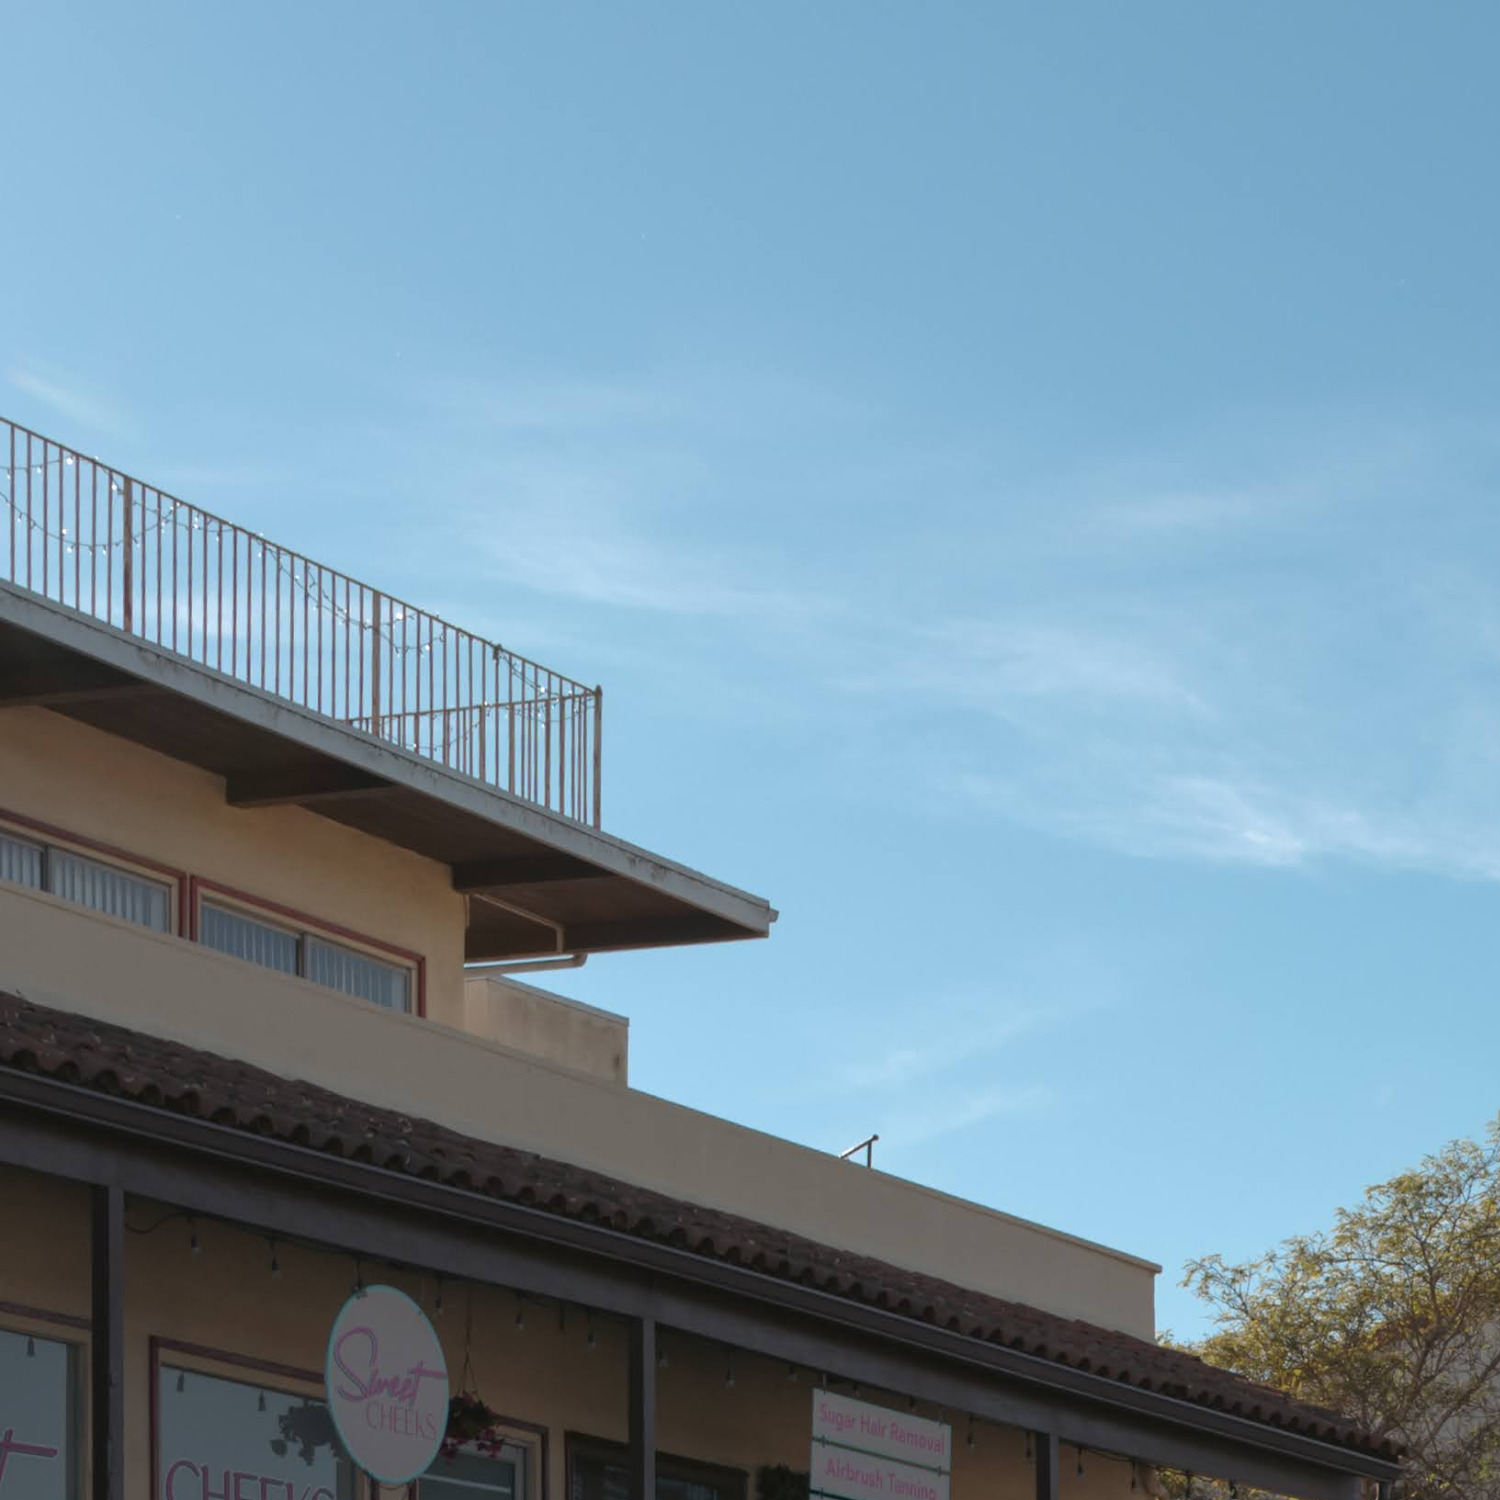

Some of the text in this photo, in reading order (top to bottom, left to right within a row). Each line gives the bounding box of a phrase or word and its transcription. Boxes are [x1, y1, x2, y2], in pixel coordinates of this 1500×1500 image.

[334, 1326, 447, 1404] Sweet
[366, 1402, 436, 1440] CHEEKS
[819, 1403, 945, 1456] Sugar Hair Removal
[825, 1457, 883, 1488] Airbrush
